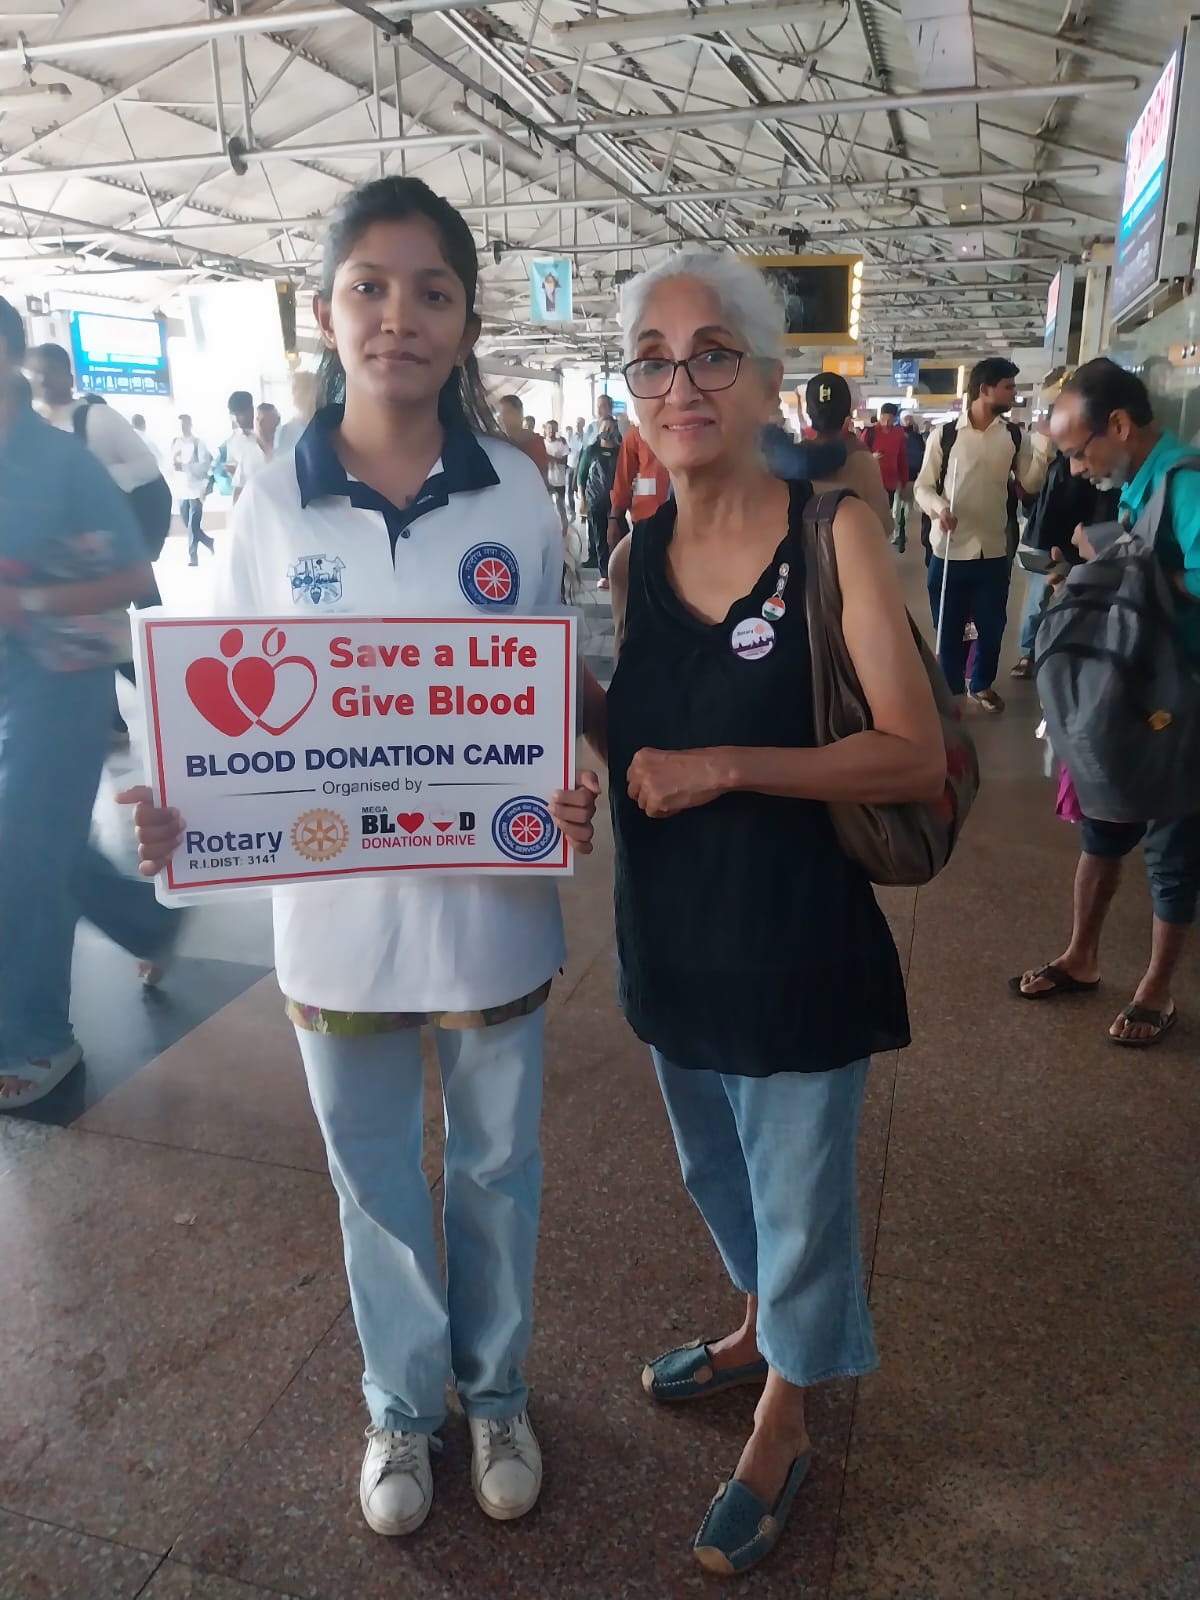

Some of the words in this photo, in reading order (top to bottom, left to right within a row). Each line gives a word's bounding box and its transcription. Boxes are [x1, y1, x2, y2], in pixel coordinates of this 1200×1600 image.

[329, 636, 420, 669] Save
[434, 645, 454, 667] a
[469, 636, 536, 667] Life
[331, 685, 415, 718] Give
[429, 686, 535, 716] Blood
[186, 751, 296, 778] BLOOD
[305, 745, 455, 771] DONATION
[463, 744, 545, 766] CAMP
[322, 777, 399, 797] Organised
[404, 777, 423, 794] by
[361, 806, 389, 814] MEGA
[187, 831, 282, 858] Rotary
[361, 835, 432, 849] DONATION
[436, 834, 476, 846] DRIVE
[248, 854, 276, 865] 3141
